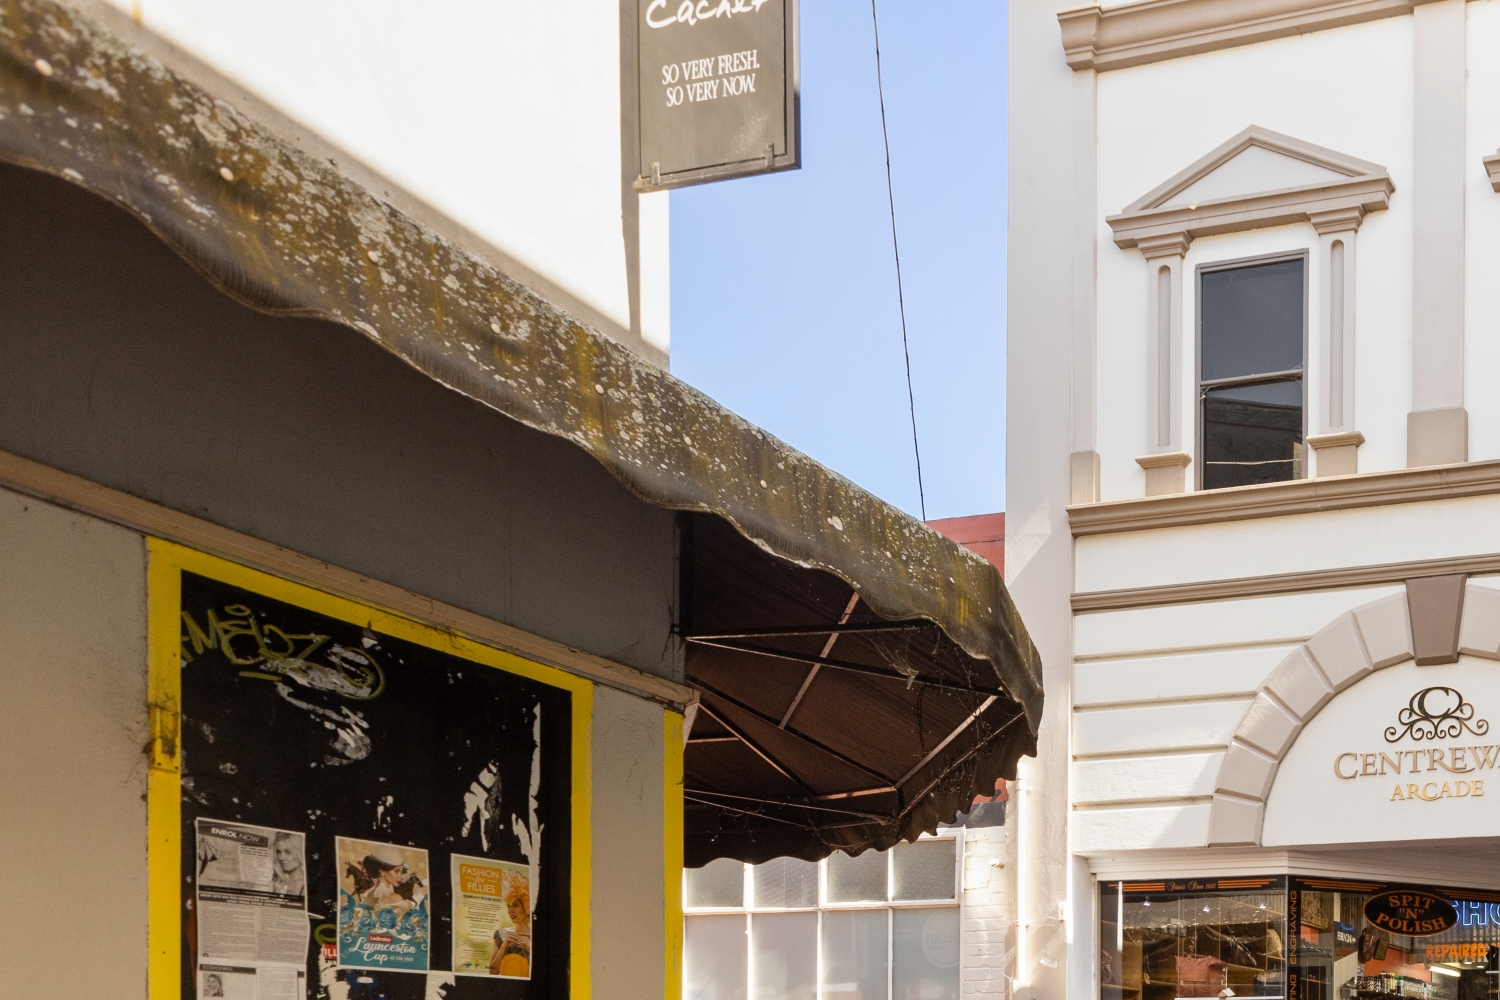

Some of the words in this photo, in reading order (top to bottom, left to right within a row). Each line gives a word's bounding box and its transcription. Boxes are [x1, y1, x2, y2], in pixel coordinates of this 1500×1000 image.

[661, 63, 680, 86] SO
[681, 57, 716, 82] VERY
[717, 49, 761, 75] FRESH.
[666, 85, 684, 107] SO
[686, 79, 718, 103] VERY
[722, 73, 756, 98] NOW.
[1389, 779, 1485, 801] ARCADE
[211, 827, 238, 839] ENROL
[238, 833, 260, 843] NOW
[462, 866, 500, 878] FASHION
[467, 882, 496, 893] FILLIES
[1388, 894, 1435, 909] SPIT
[1289, 890, 1297, 965] ENGRAVING
[1375, 912, 1448, 932] POLISH
[349, 937, 417, 954] Launceston
[1426, 942, 1487, 960] REPAIRED
[363, 950, 389, 965] Cup
